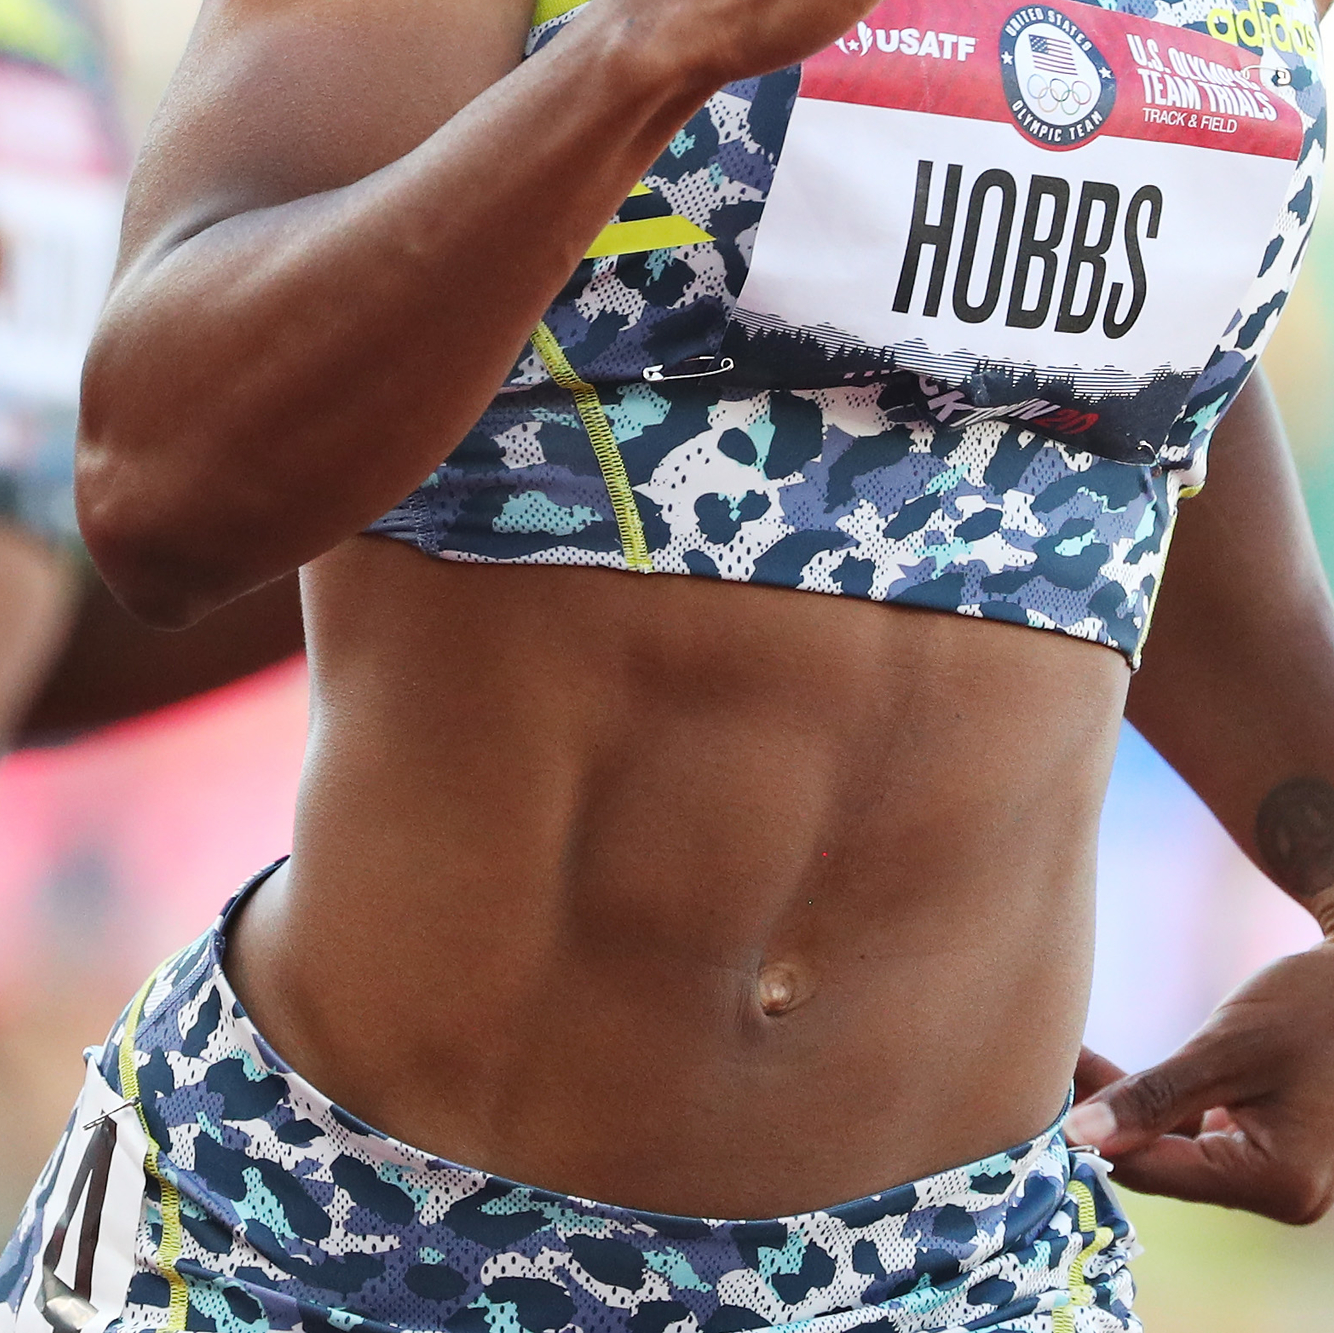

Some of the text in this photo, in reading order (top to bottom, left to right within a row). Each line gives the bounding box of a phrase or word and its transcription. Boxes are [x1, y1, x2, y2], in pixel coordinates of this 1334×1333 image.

[875, 27, 977, 62] USATF
[1004, 7, 1093, 52] UNITED STATES
[1126, 33, 1171, 75] U.S.
[1137, 68, 1278, 121] TEAM TRIALS
[1012, 99, 1103, 142] OLYMPIC TEAM
[1142, 107, 1238, 134] TRACK & FIELD
[892, 159, 1164, 339] HOBBS
